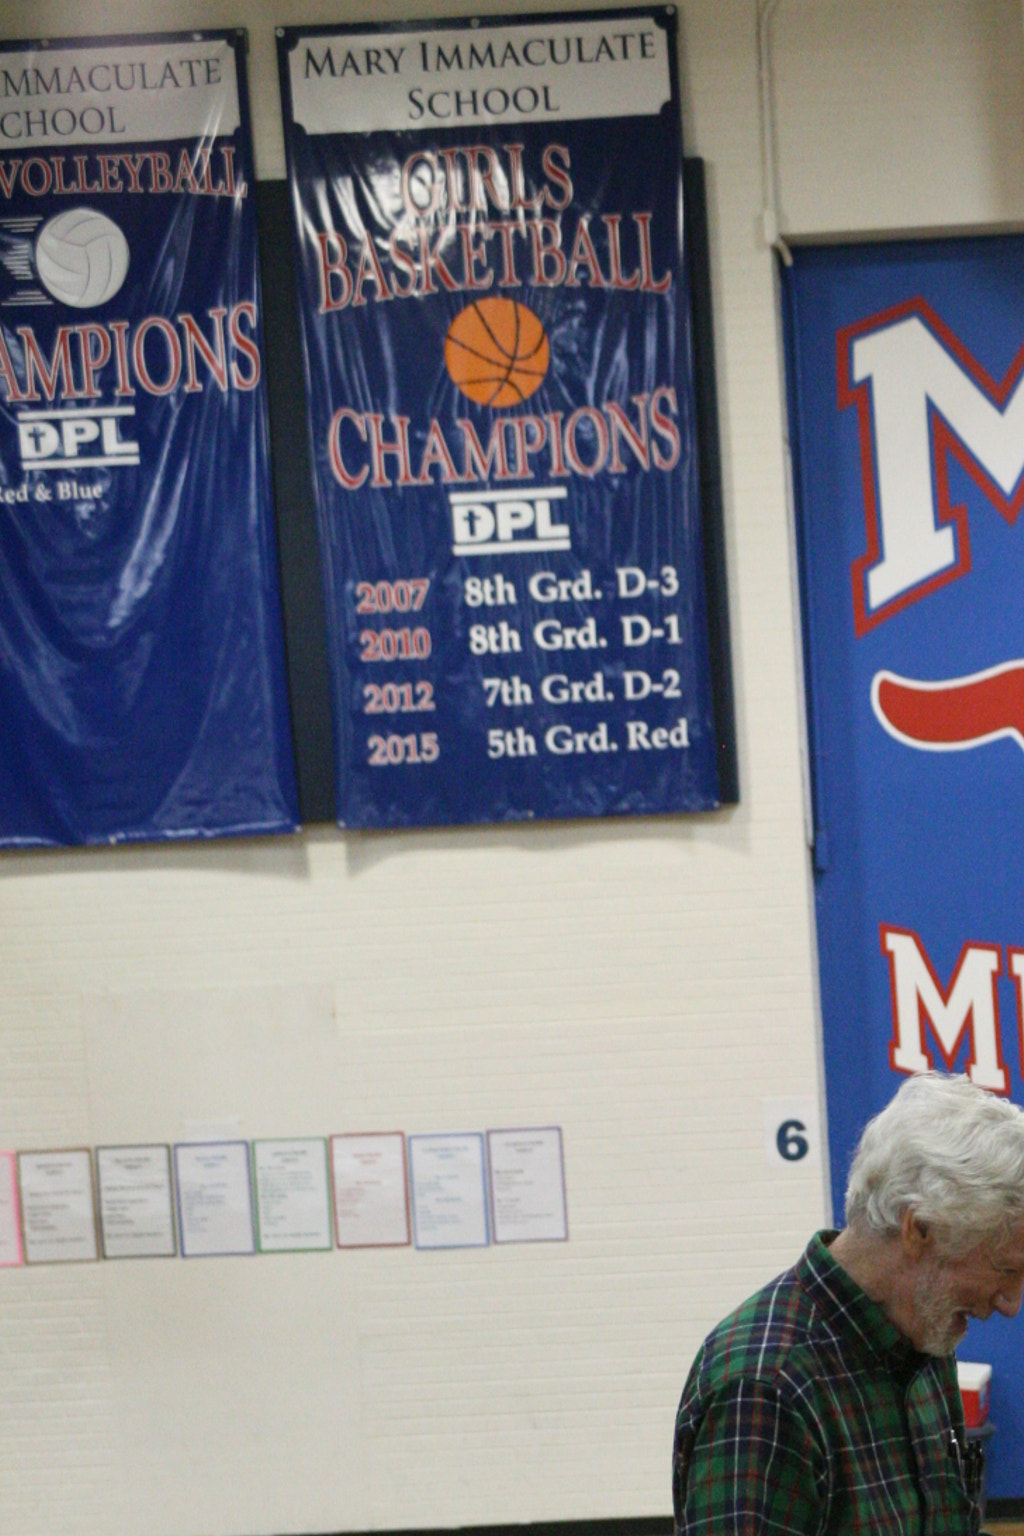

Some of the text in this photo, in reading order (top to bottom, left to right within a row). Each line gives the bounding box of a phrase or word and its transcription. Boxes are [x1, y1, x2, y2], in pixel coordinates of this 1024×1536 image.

[304, 31, 656, 79] MARY IMMACULATE
[407, 85, 560, 120] SCHOOL
[0, 146, 248, 199] VOLLEYBALL
[402, 142, 574, 217] GIRLS
[317, 211, 672, 314] BASKETBALL
[18, 415, 139, 458] DPL
[328, 387, 682, 489] CHAMPIONS
[35, 482, 52, 502] &
[57, 481, 103, 500] Blue
[451, 499, 570, 545] DPL
[355, 566, 679, 613] 2007 8th Grd. D-3
[360, 614, 682, 661] 2010 8th Grd. D-1
[363, 669, 682, 714] 2012 7th Grd. D-2
[367, 719, 689, 766] 2015 5th Grd. Red
[776, 1119, 809, 1161] 6
